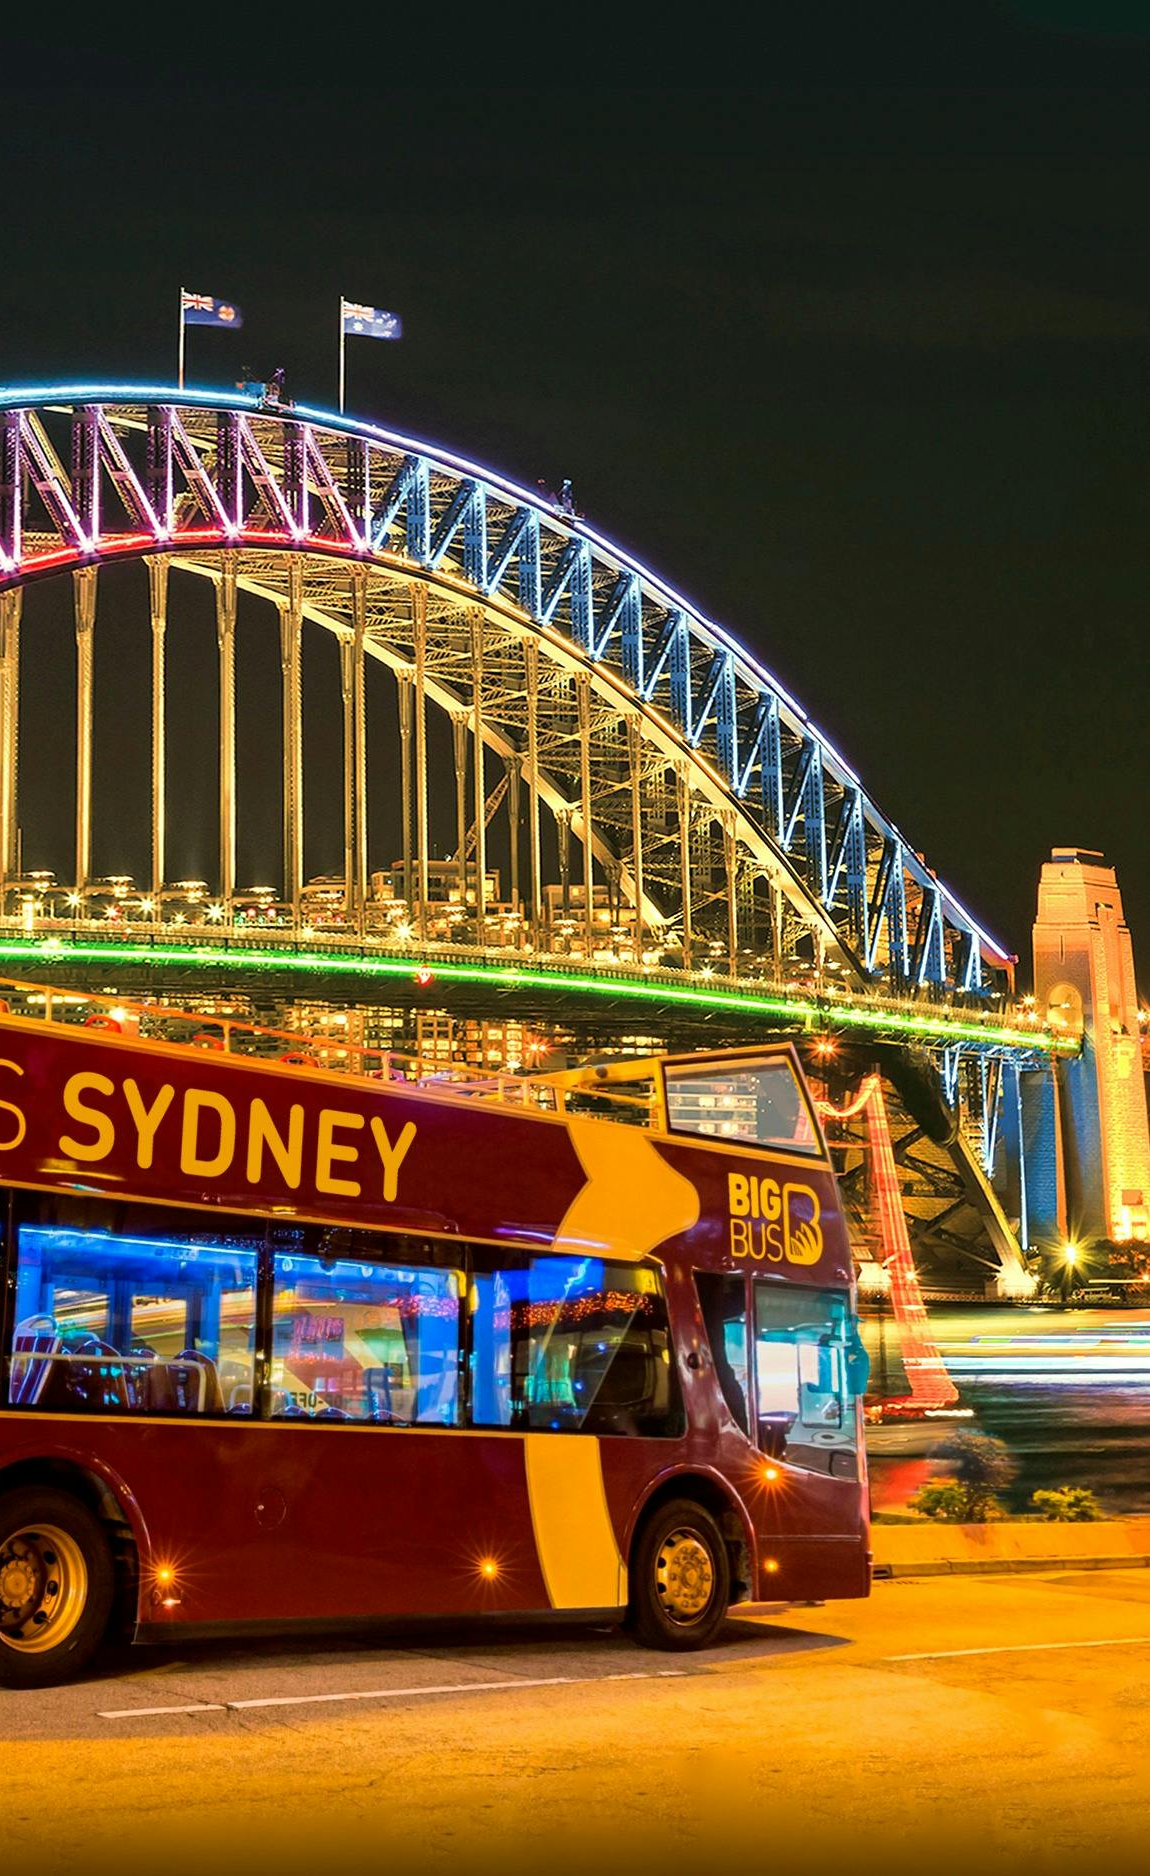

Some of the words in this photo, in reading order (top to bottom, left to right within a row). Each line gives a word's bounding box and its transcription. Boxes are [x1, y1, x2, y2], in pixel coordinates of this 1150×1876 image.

[58, 1071, 417, 1202] SYDNEY
[728, 1172, 782, 1221] BIG
[730, 1218, 783, 1262] BUS
